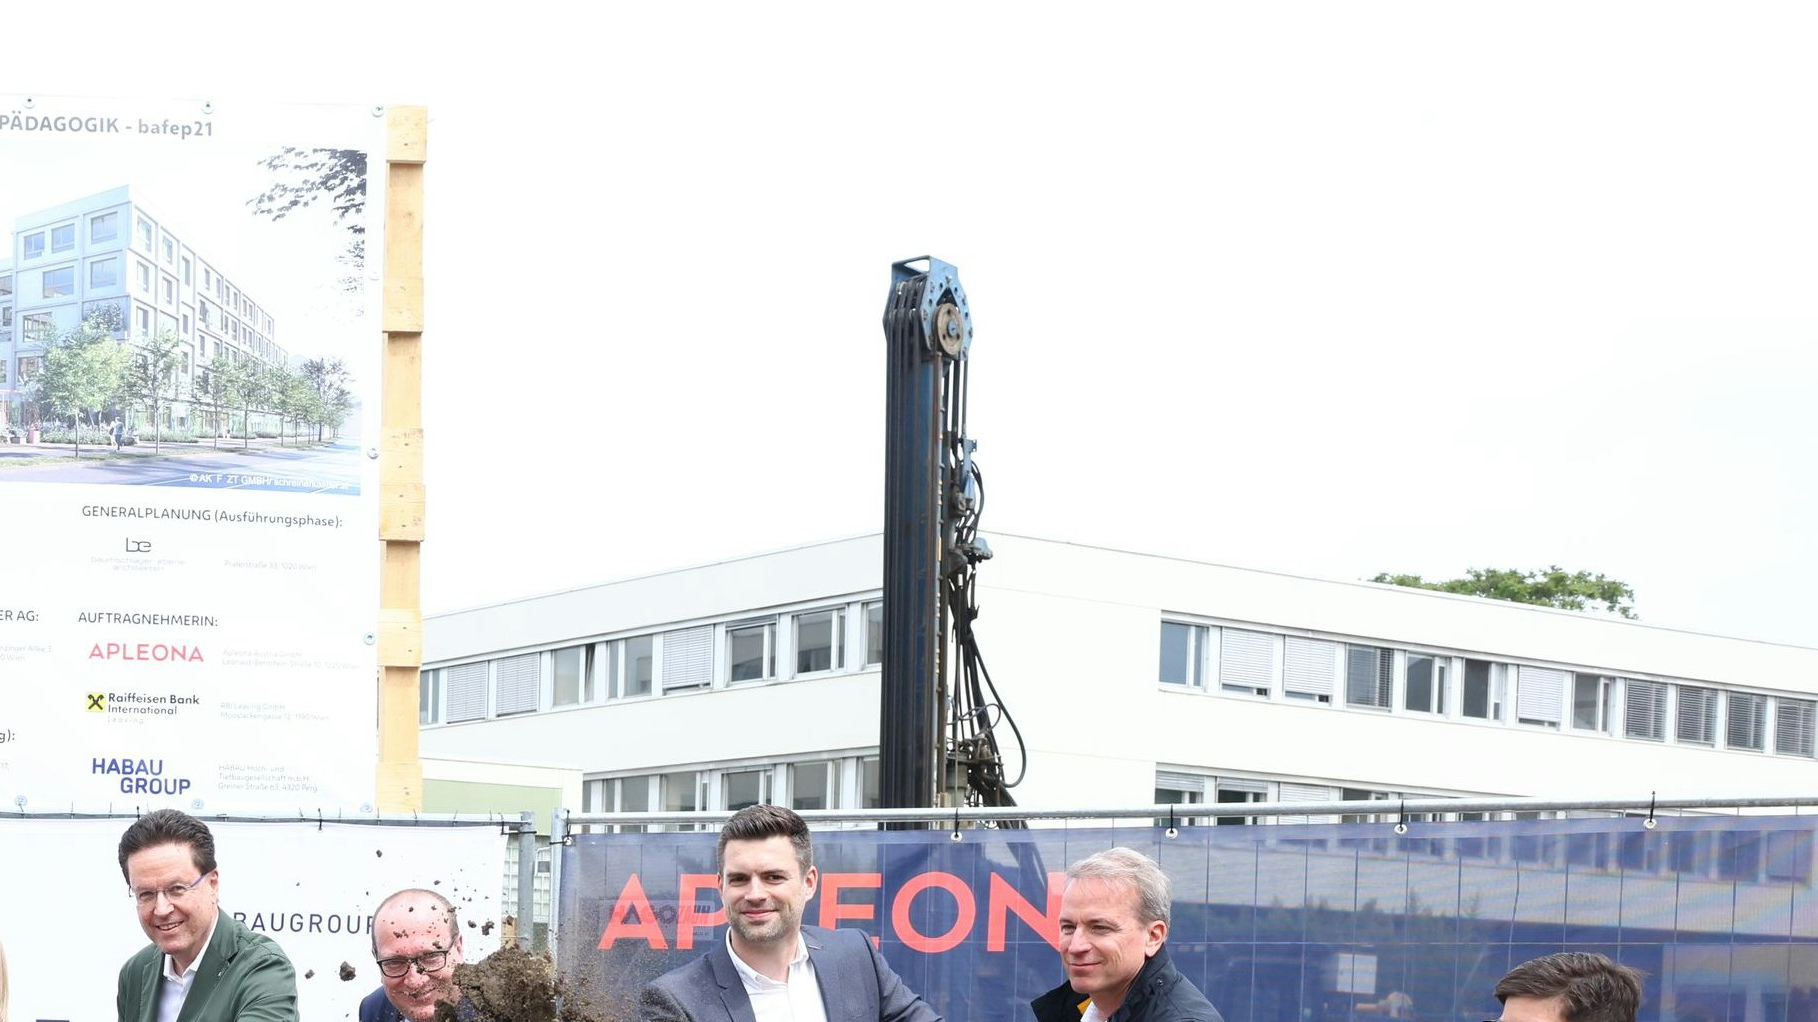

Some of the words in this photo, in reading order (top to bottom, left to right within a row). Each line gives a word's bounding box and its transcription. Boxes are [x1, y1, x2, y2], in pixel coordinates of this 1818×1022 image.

[139, 119, 211, 140] bafep21
[82, 506, 210, 520] GENERALPLANUNG
[215, 510, 342, 528] (Ausführungsphase):
[17, 611, 38, 621] AG:
[78, 612, 217, 626] AUFTRAGNEHMERIN:
[89, 643, 204, 662] APLEONA
[109, 693, 166, 705] Raiffeisen
[170, 695, 199, 704] Bank
[108, 704, 177, 714] International
[92, 758, 162, 776] HABAU
[121, 777, 190, 795] GROUP
[598, 872, 1061, 953] APEON
